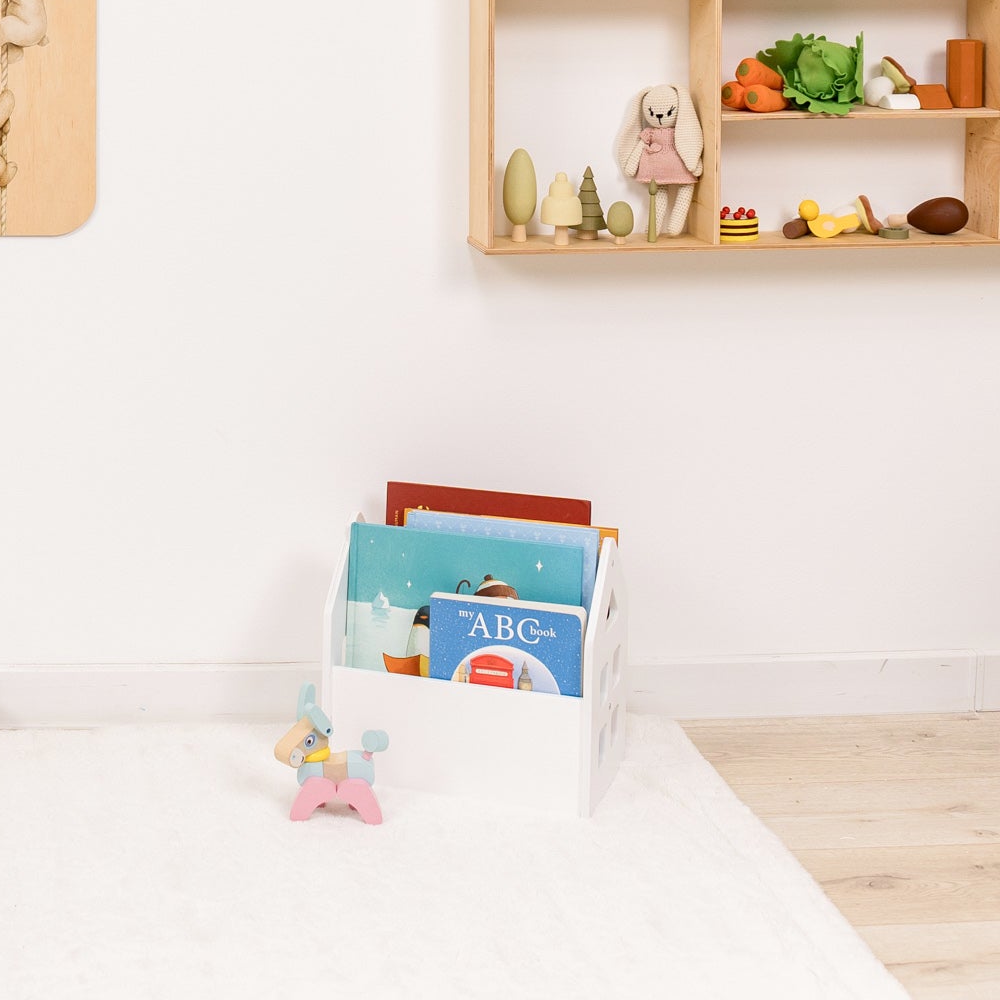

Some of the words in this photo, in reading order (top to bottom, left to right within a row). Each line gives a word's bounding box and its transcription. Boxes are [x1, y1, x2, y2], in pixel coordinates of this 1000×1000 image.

[459, 610, 475, 621] my
[467, 612, 540, 644] ABC
[530, 625, 557, 638] book
